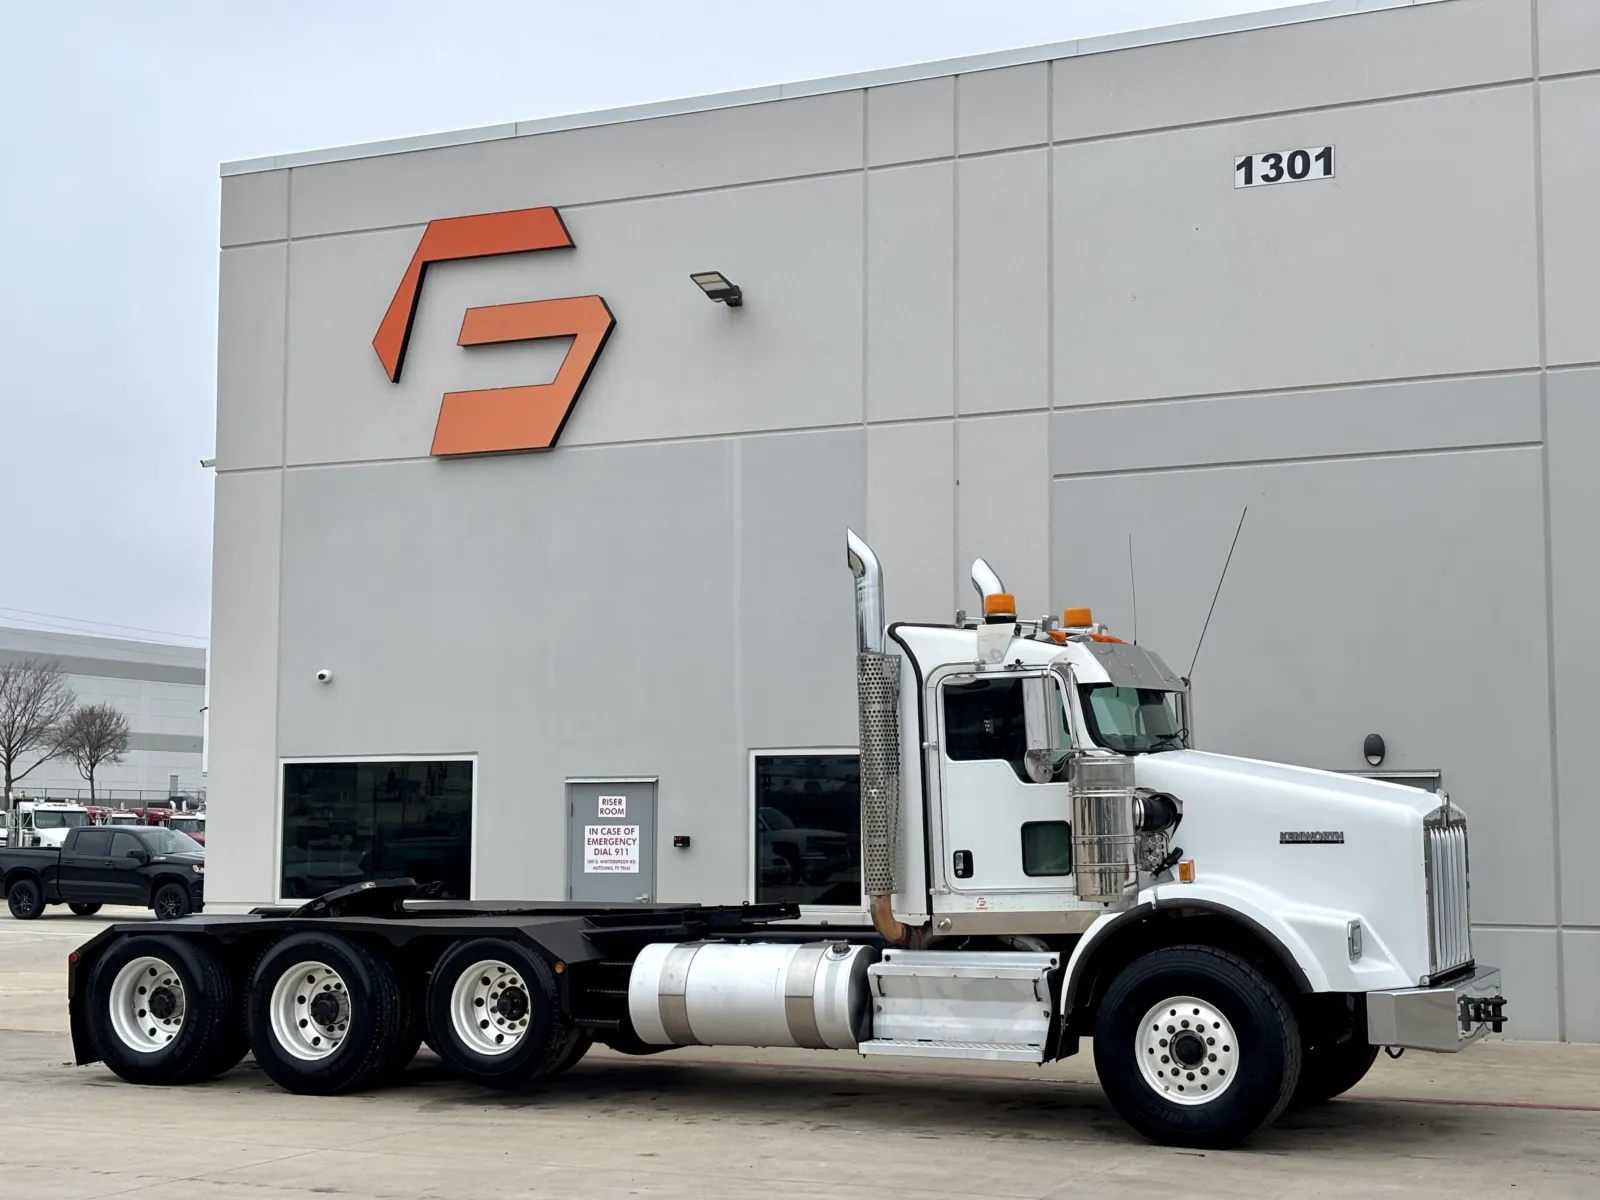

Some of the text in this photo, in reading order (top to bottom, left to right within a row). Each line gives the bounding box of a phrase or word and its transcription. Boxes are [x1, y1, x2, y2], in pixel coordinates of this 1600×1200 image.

[1236, 146, 1332, 185] 1301
[602, 798, 623, 806] RISER
[600, 807, 625, 815] ROOM
[589, 827, 635, 835] IN CASE OF
[587, 837, 637, 845] EMERGENCY
[1279, 831, 1344, 843] KENWORTH
